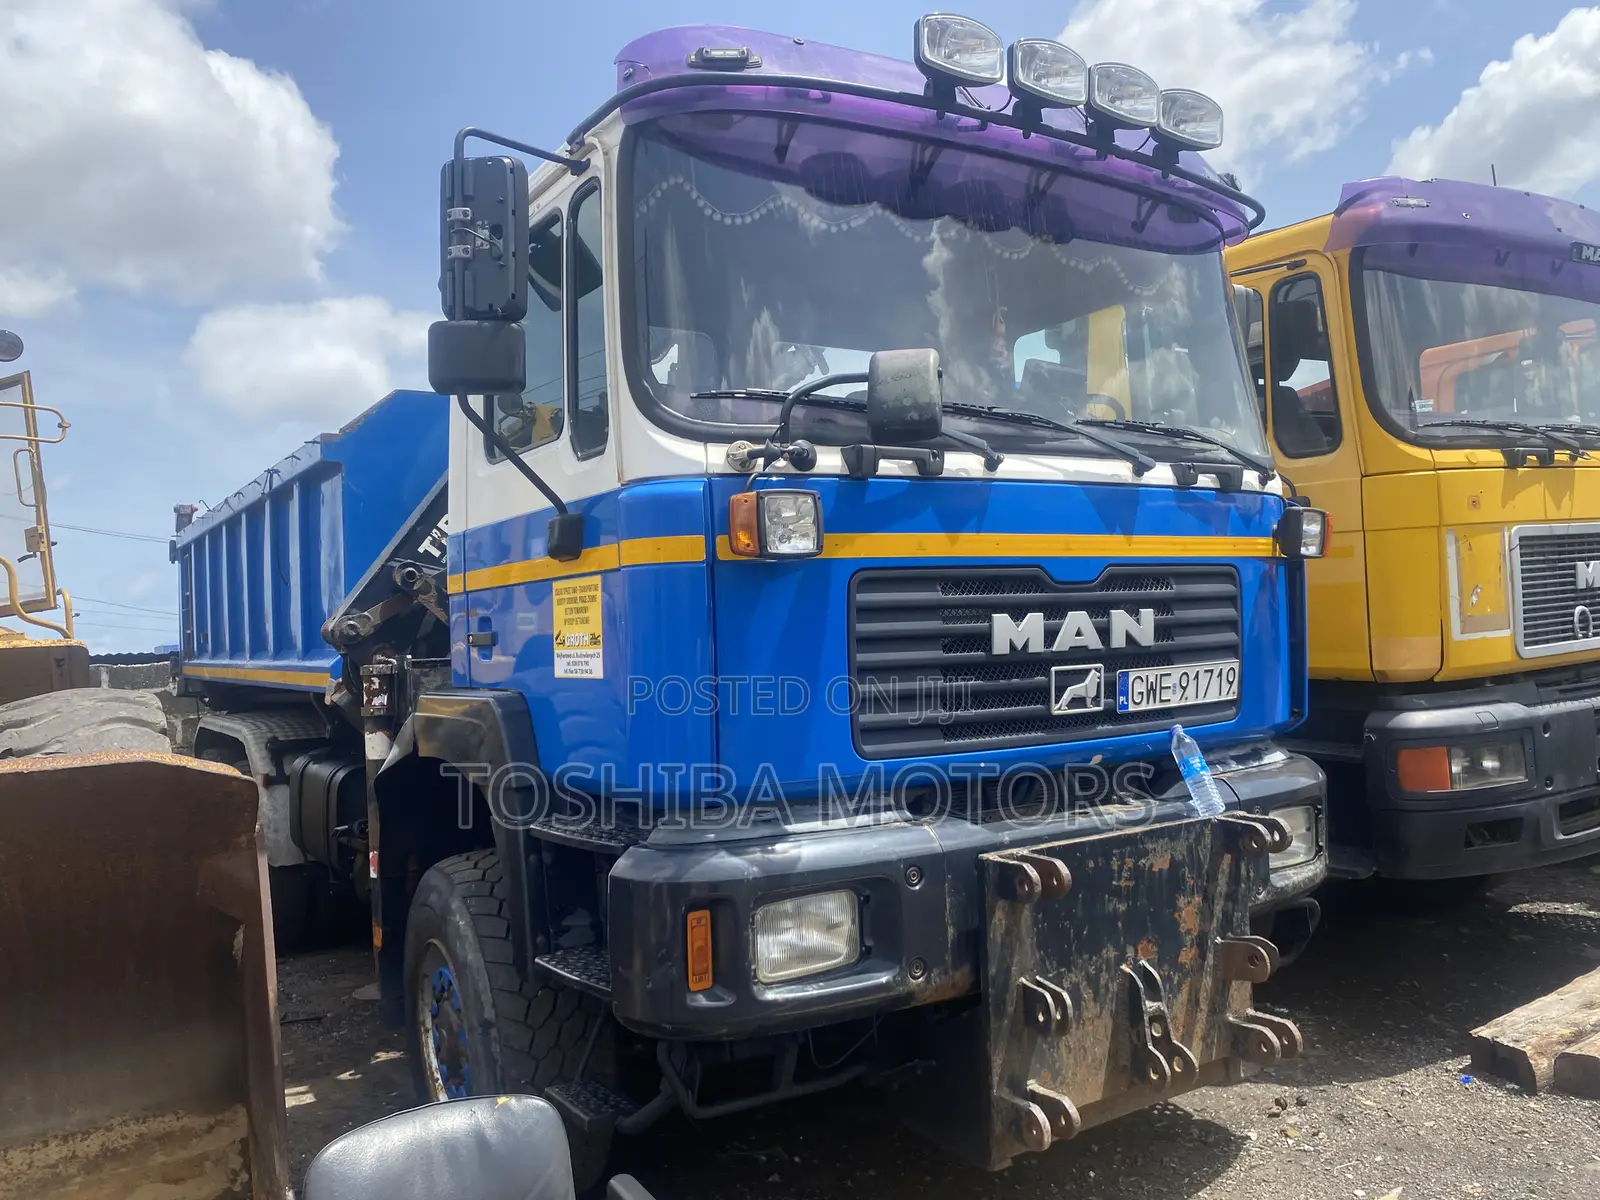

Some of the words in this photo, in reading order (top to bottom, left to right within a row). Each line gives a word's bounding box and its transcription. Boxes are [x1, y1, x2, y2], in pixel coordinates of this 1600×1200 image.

[991, 609, 1155, 655] MAN
[1119, 695, 1128, 705] PL
[1131, 672, 1172, 706] GWE
[1178, 666, 1237, 702] 91719
